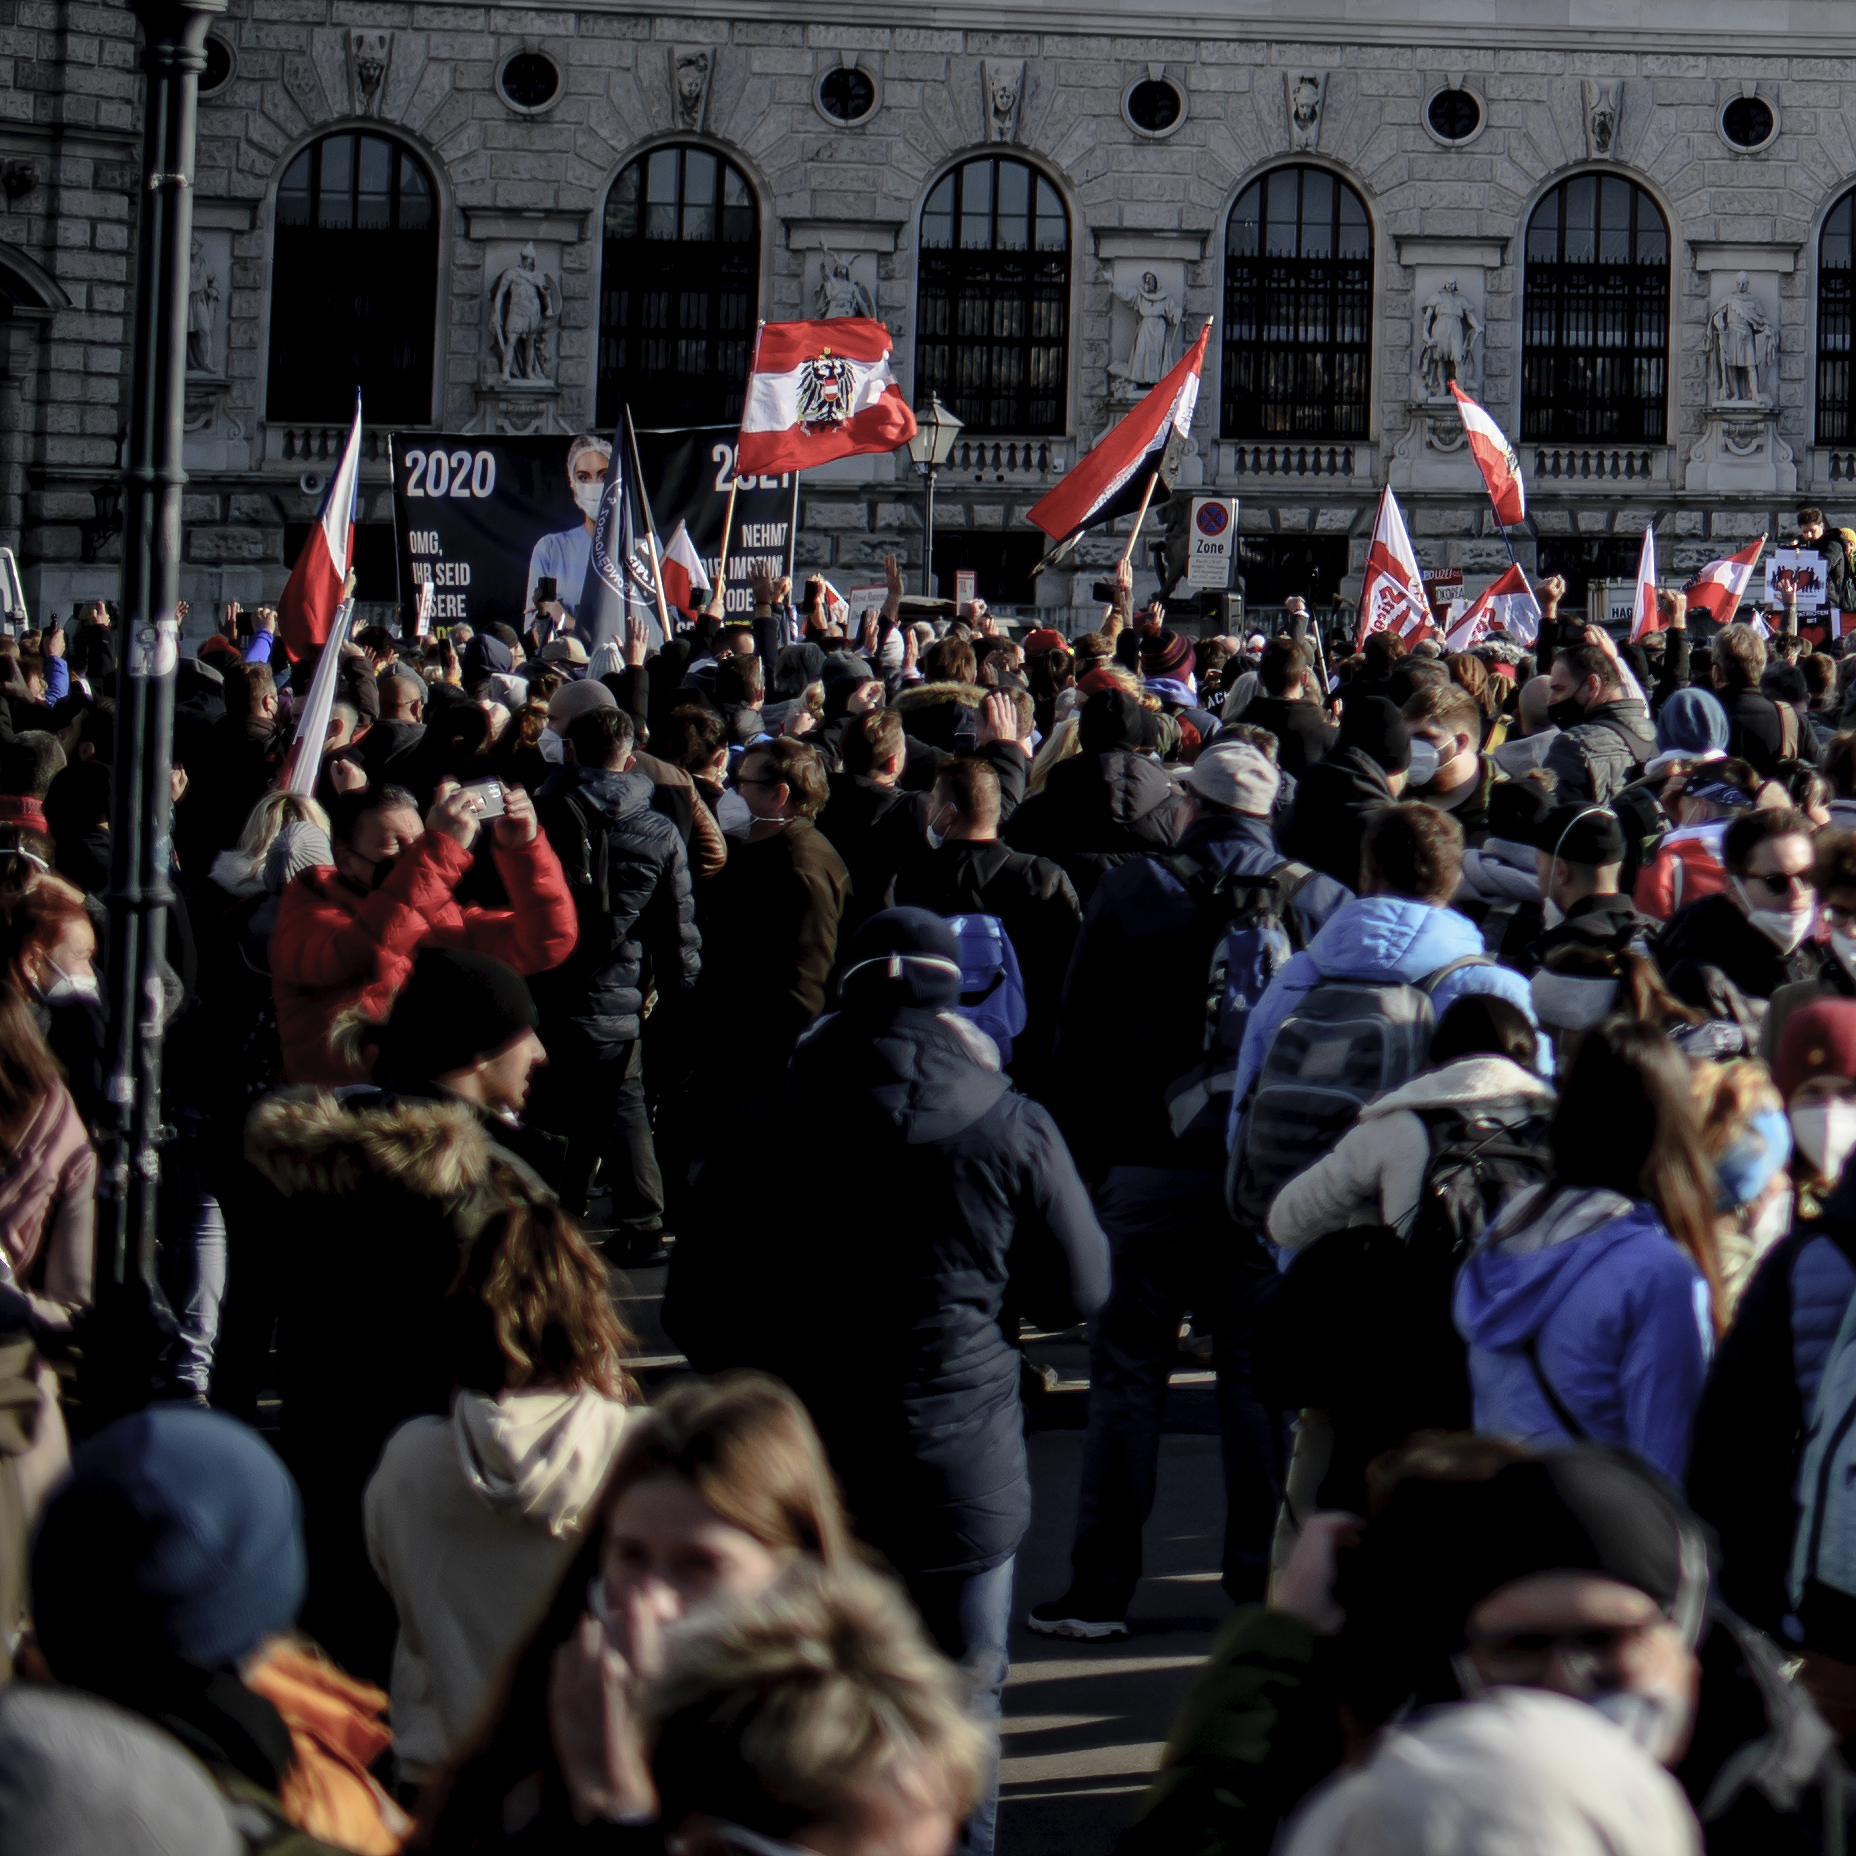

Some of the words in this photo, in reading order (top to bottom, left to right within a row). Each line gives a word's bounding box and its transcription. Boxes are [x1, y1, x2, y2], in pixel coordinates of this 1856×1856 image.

[405, 450, 496, 497] 2020
[410, 531, 442, 557] OMG,
[1196, 538, 1224, 554] Zone
[435, 562, 471, 586] SEID
